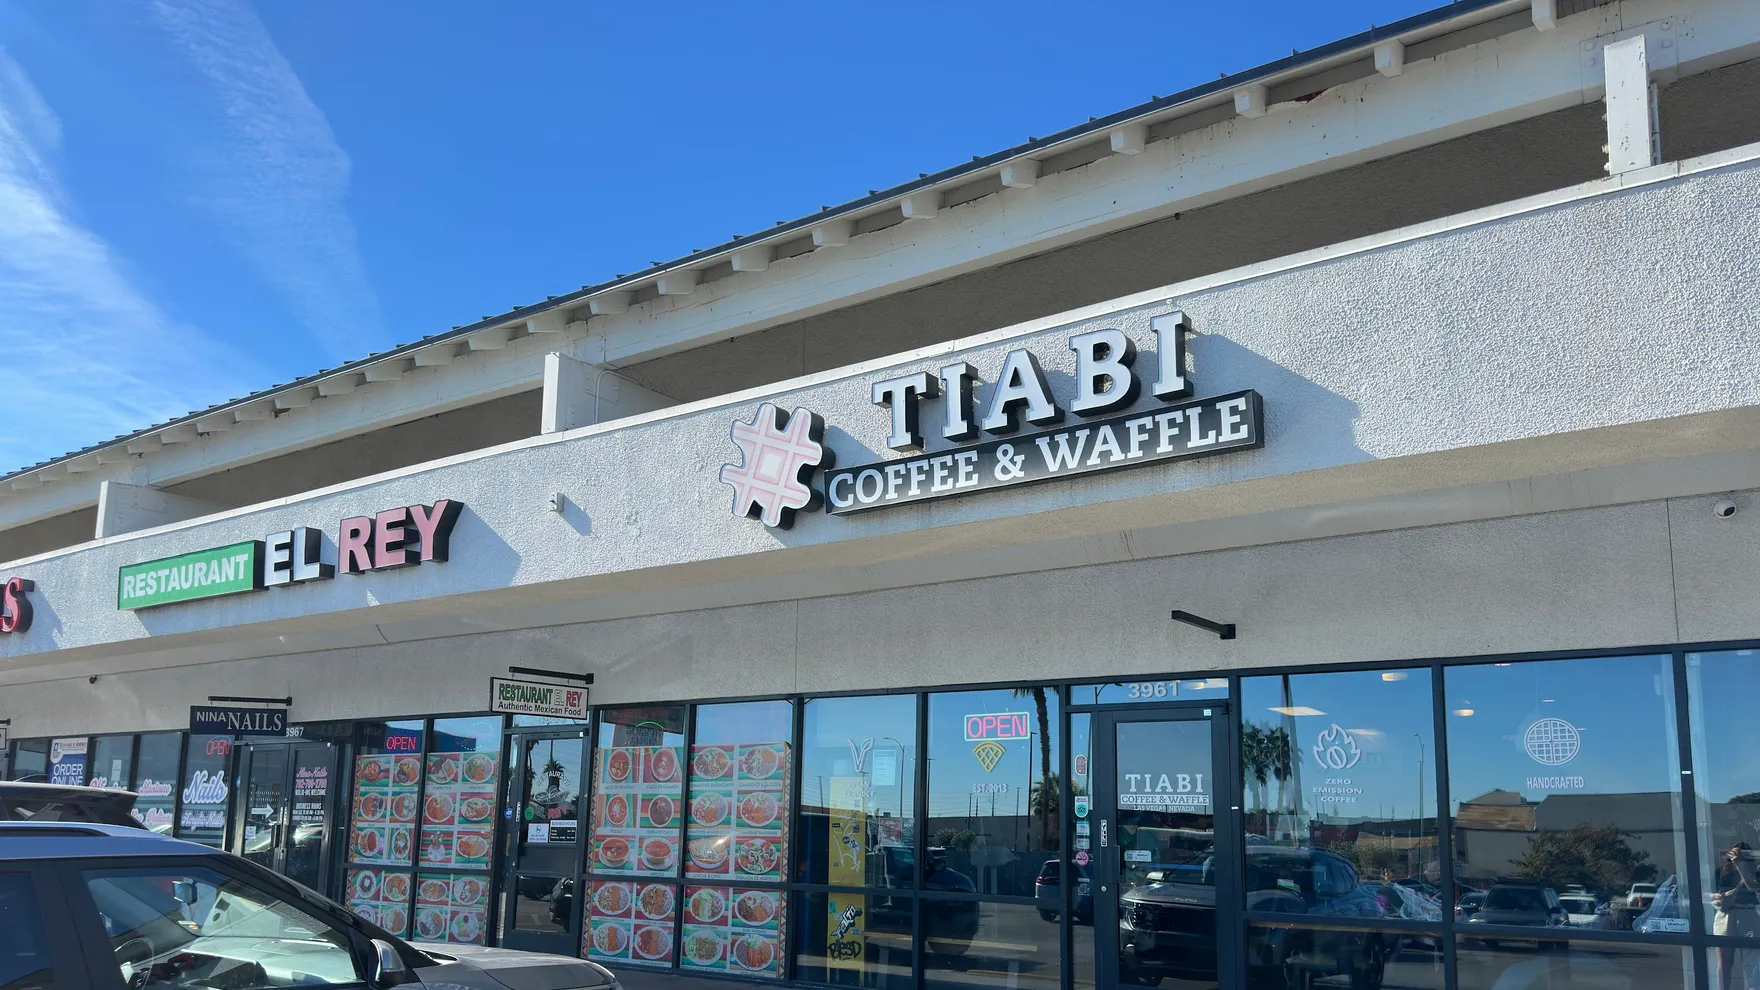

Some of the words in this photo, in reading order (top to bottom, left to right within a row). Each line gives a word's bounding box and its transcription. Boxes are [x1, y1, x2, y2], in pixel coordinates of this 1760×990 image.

[872, 310, 1192, 452] TIABI
[829, 448, 980, 509] COFFEE
[994, 446, 1025, 481] &
[1035, 396, 1249, 473] WAFFLE
[122, 553, 249, 600] RESTAURANT
[264, 527, 328, 587] EL
[338, 499, 456, 575] REY
[498, 682, 553, 706] RESTAURANT
[554, 688, 564, 707] EL
[566, 690, 583, 708] REY
[1127, 679, 1180, 699] 3961
[497, 701, 533, 712] Authentic
[534, 703, 563, 715] Mexican
[564, 707, 582, 716] Food
[196, 711, 227, 723] NINA
[226, 711, 283, 731] NAILS
[967, 714, 1027, 739] OPEN
[285, 726, 304, 738] 3967
[205, 740, 231, 756] OPEN
[386, 736, 417, 751] OPEN
[53, 763, 84, 776] ORDER
[182, 769, 229, 804] Nails
[1125, 773, 1204, 793] TIABI
[1526, 776, 1585, 789] HANDCRAFTED
[1121, 795, 1157, 804] COFFEE
[1158, 795, 1166, 804] &
[1168, 795, 1208, 804] WAFFLE
